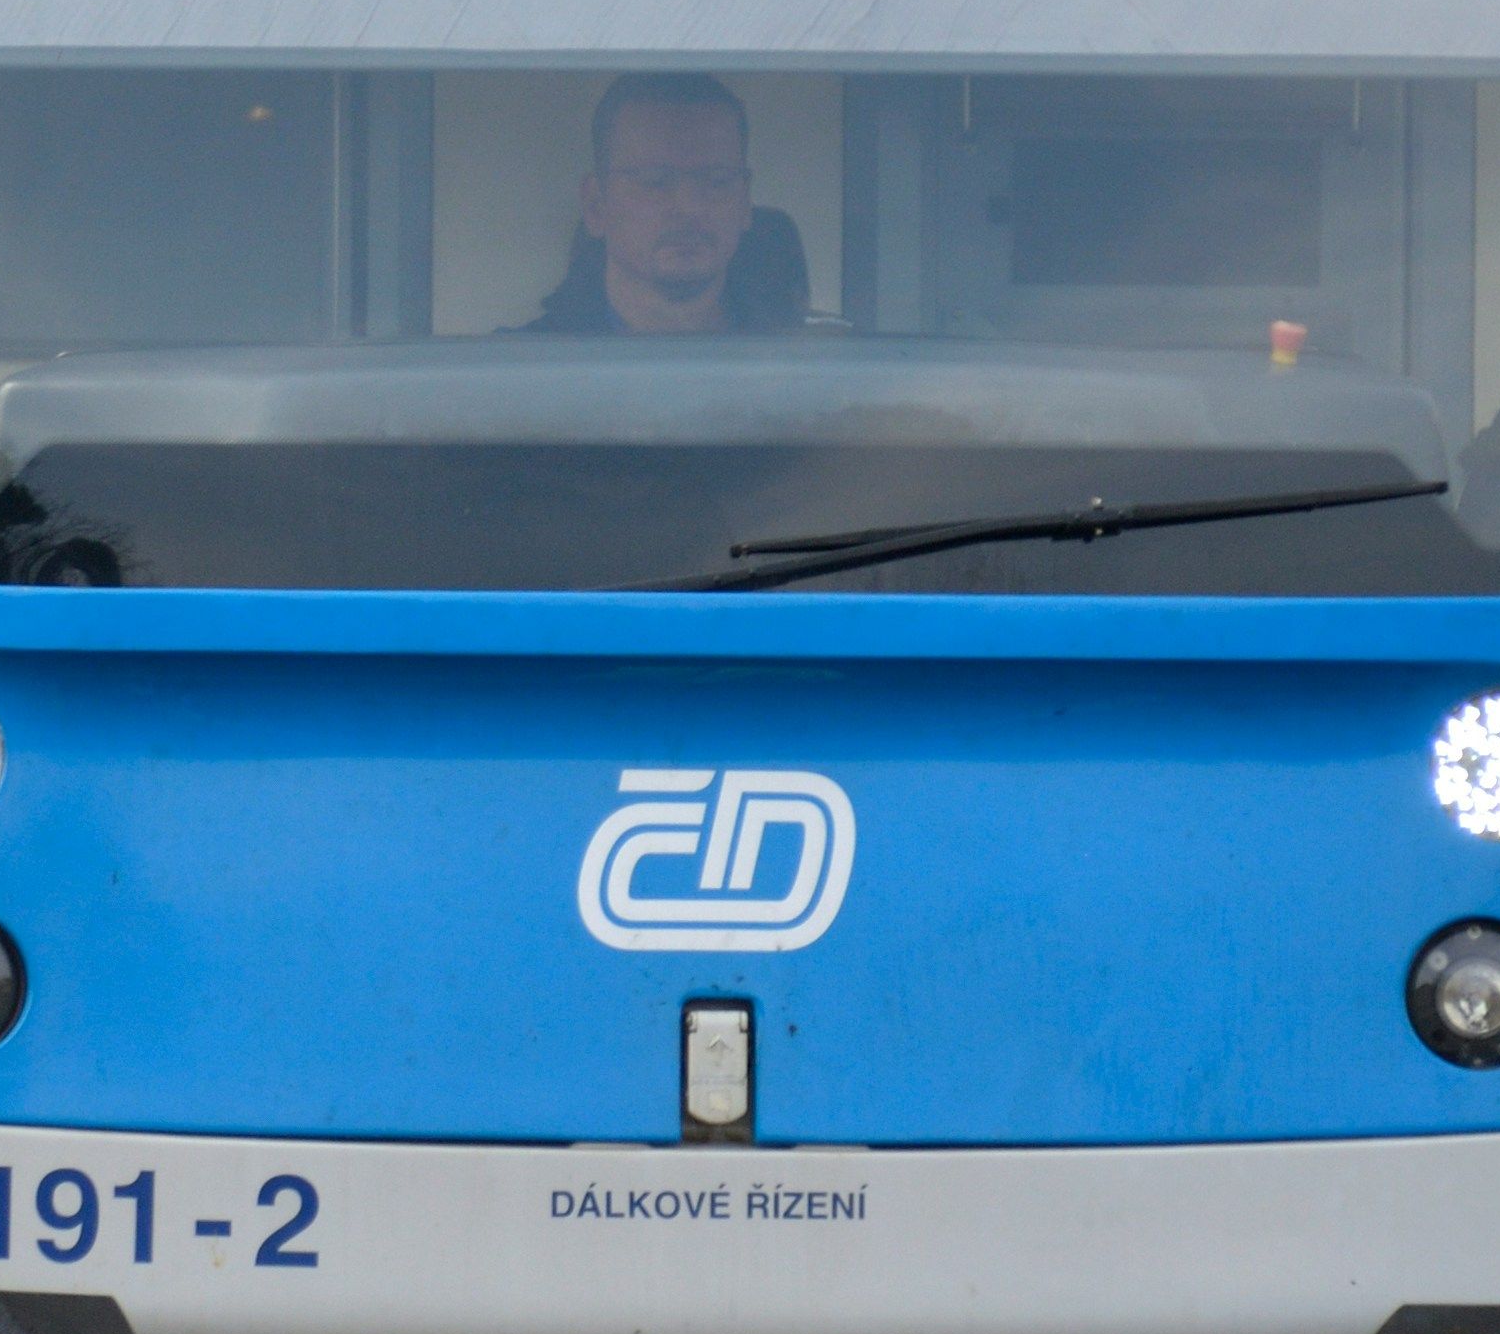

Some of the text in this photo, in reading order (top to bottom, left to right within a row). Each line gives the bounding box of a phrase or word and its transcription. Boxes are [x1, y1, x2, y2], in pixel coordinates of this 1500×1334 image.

[576, 768, 858, 953] ČD
[550, 1182, 868, 1220] DÁLKOVÉ ŘÍZENÍ
